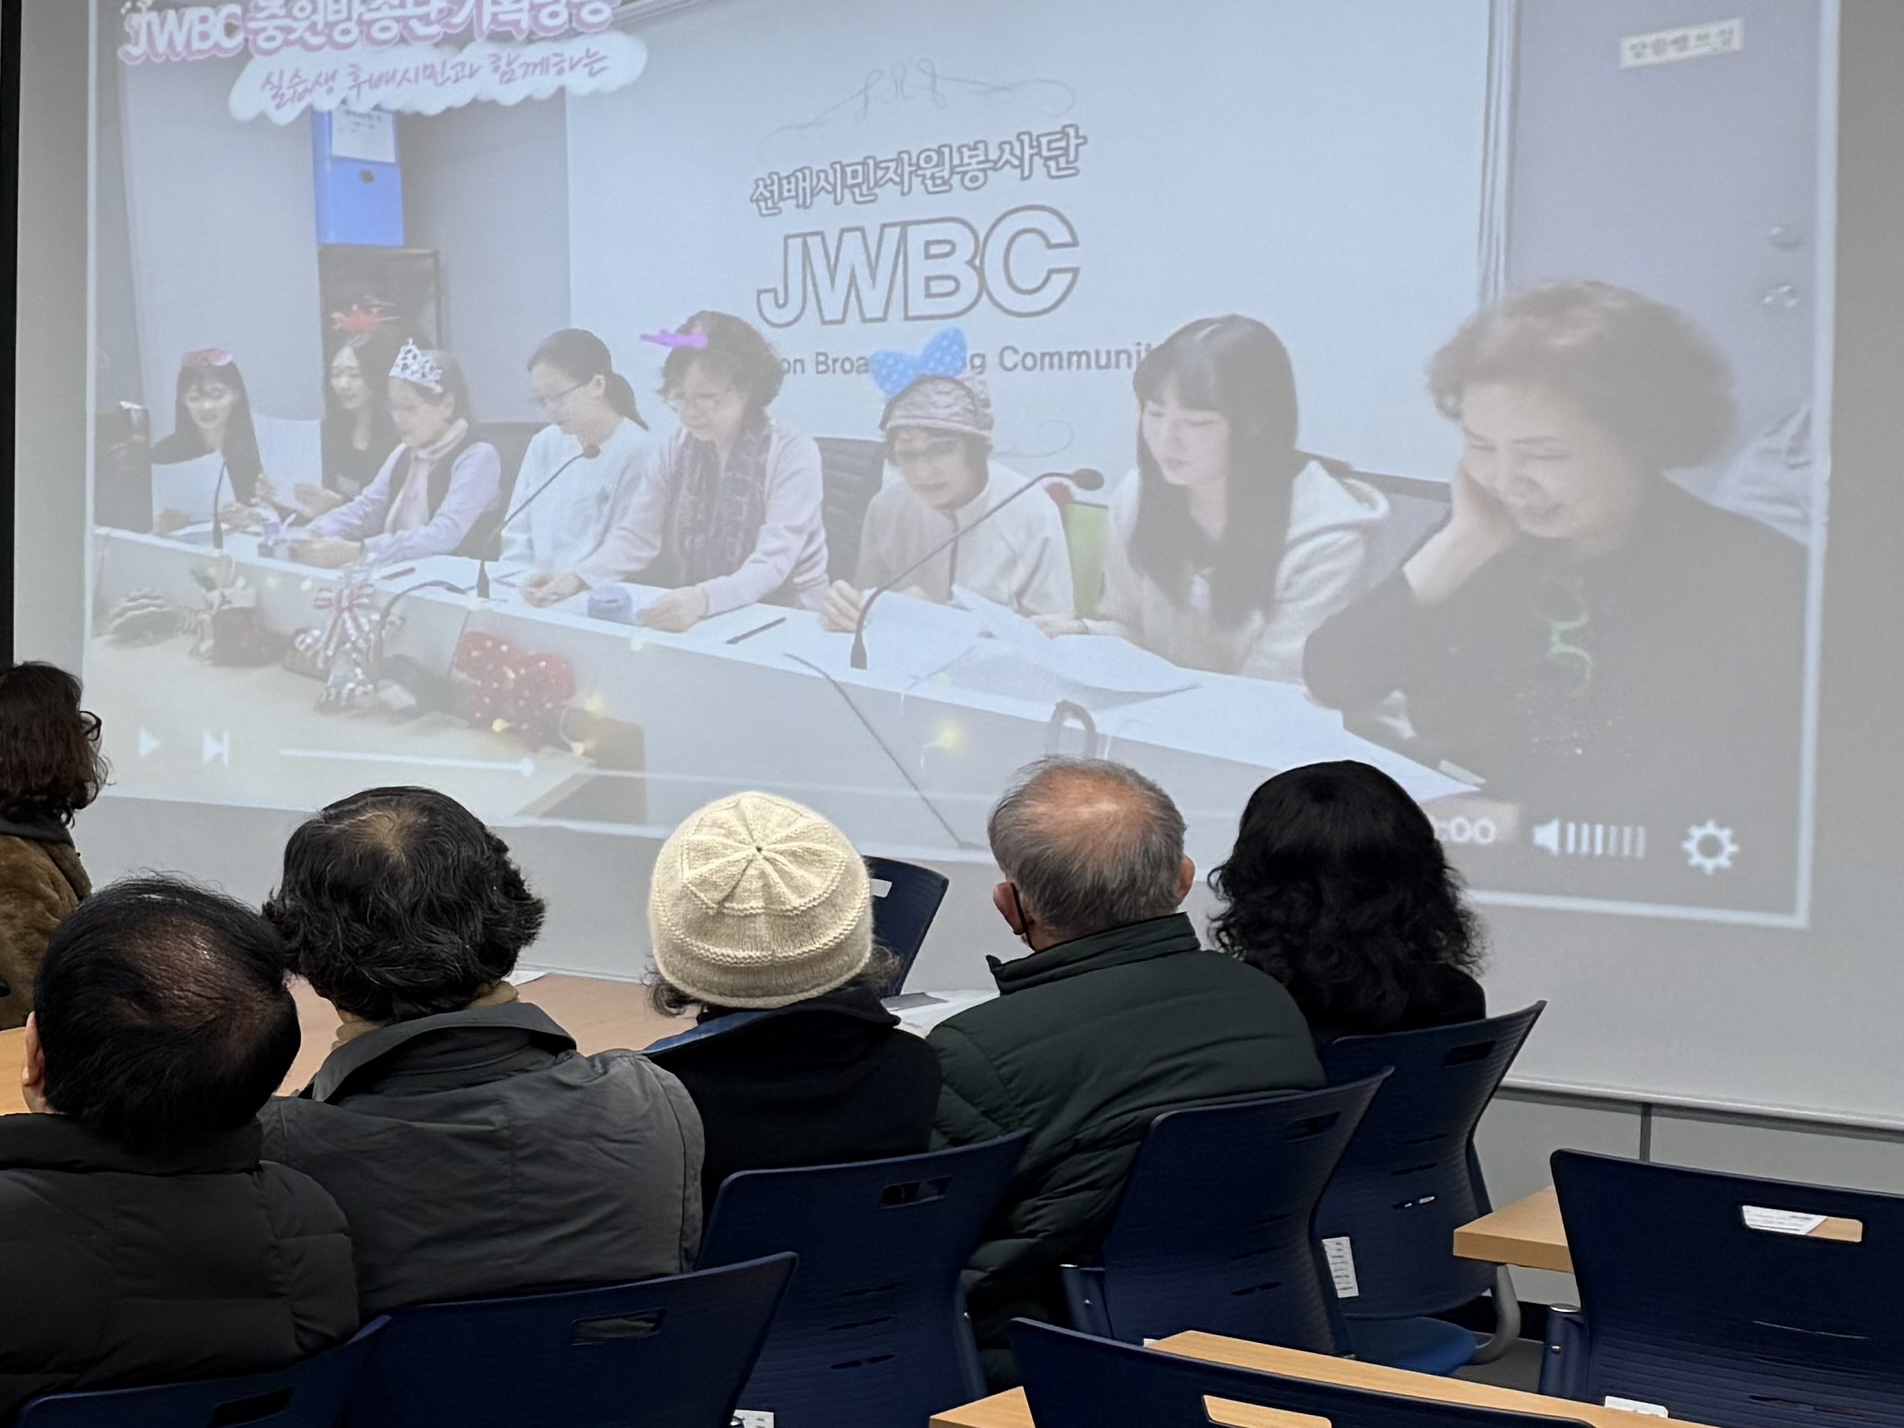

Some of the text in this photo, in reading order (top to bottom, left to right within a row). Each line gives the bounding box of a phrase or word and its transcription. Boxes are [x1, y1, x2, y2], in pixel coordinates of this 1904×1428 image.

[119, 4, 242, 62] JWBC
[261, 69, 338, 110] 실습생
[488, 48, 608, 84] 함께하는
[750, 124, 1087, 217] 선배시민자원봉사단
[756, 204, 1080, 329] JWBC
